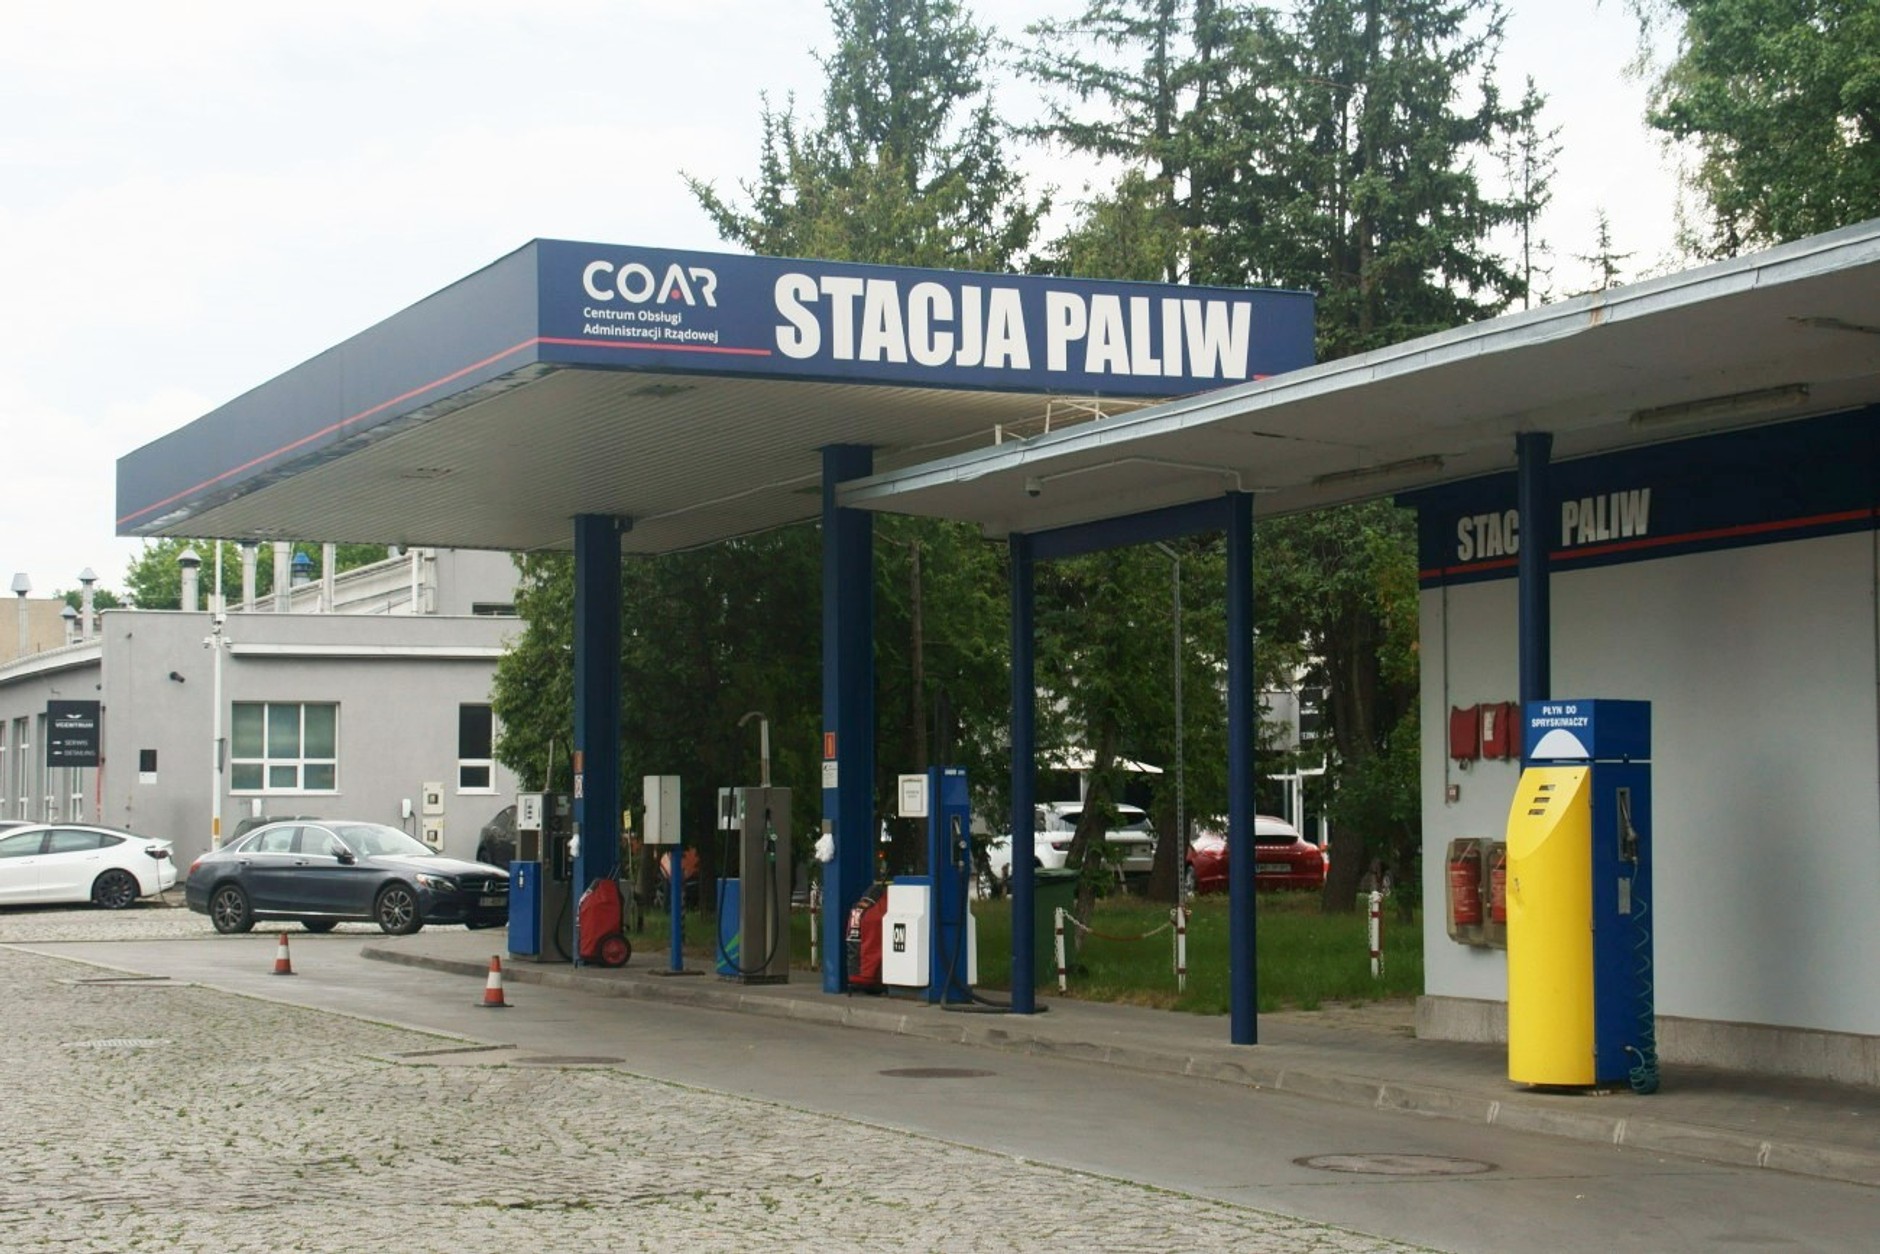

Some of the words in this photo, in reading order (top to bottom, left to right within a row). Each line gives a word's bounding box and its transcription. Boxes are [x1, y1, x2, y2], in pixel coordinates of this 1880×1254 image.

[583, 260, 717, 307] COAR
[583, 306, 636, 321] Centrum
[638, 310, 682, 326] Obsługi
[774, 273, 1031, 370] STACJA
[1046, 290, 1252, 379] PALIW
[583, 323, 662, 341] Administracji
[664, 328, 719, 344] Rządowej
[1457, 509, 1520, 562] STAC
[1562, 487, 1651, 546] PALIW
[1565, 705, 1577, 715] DO
